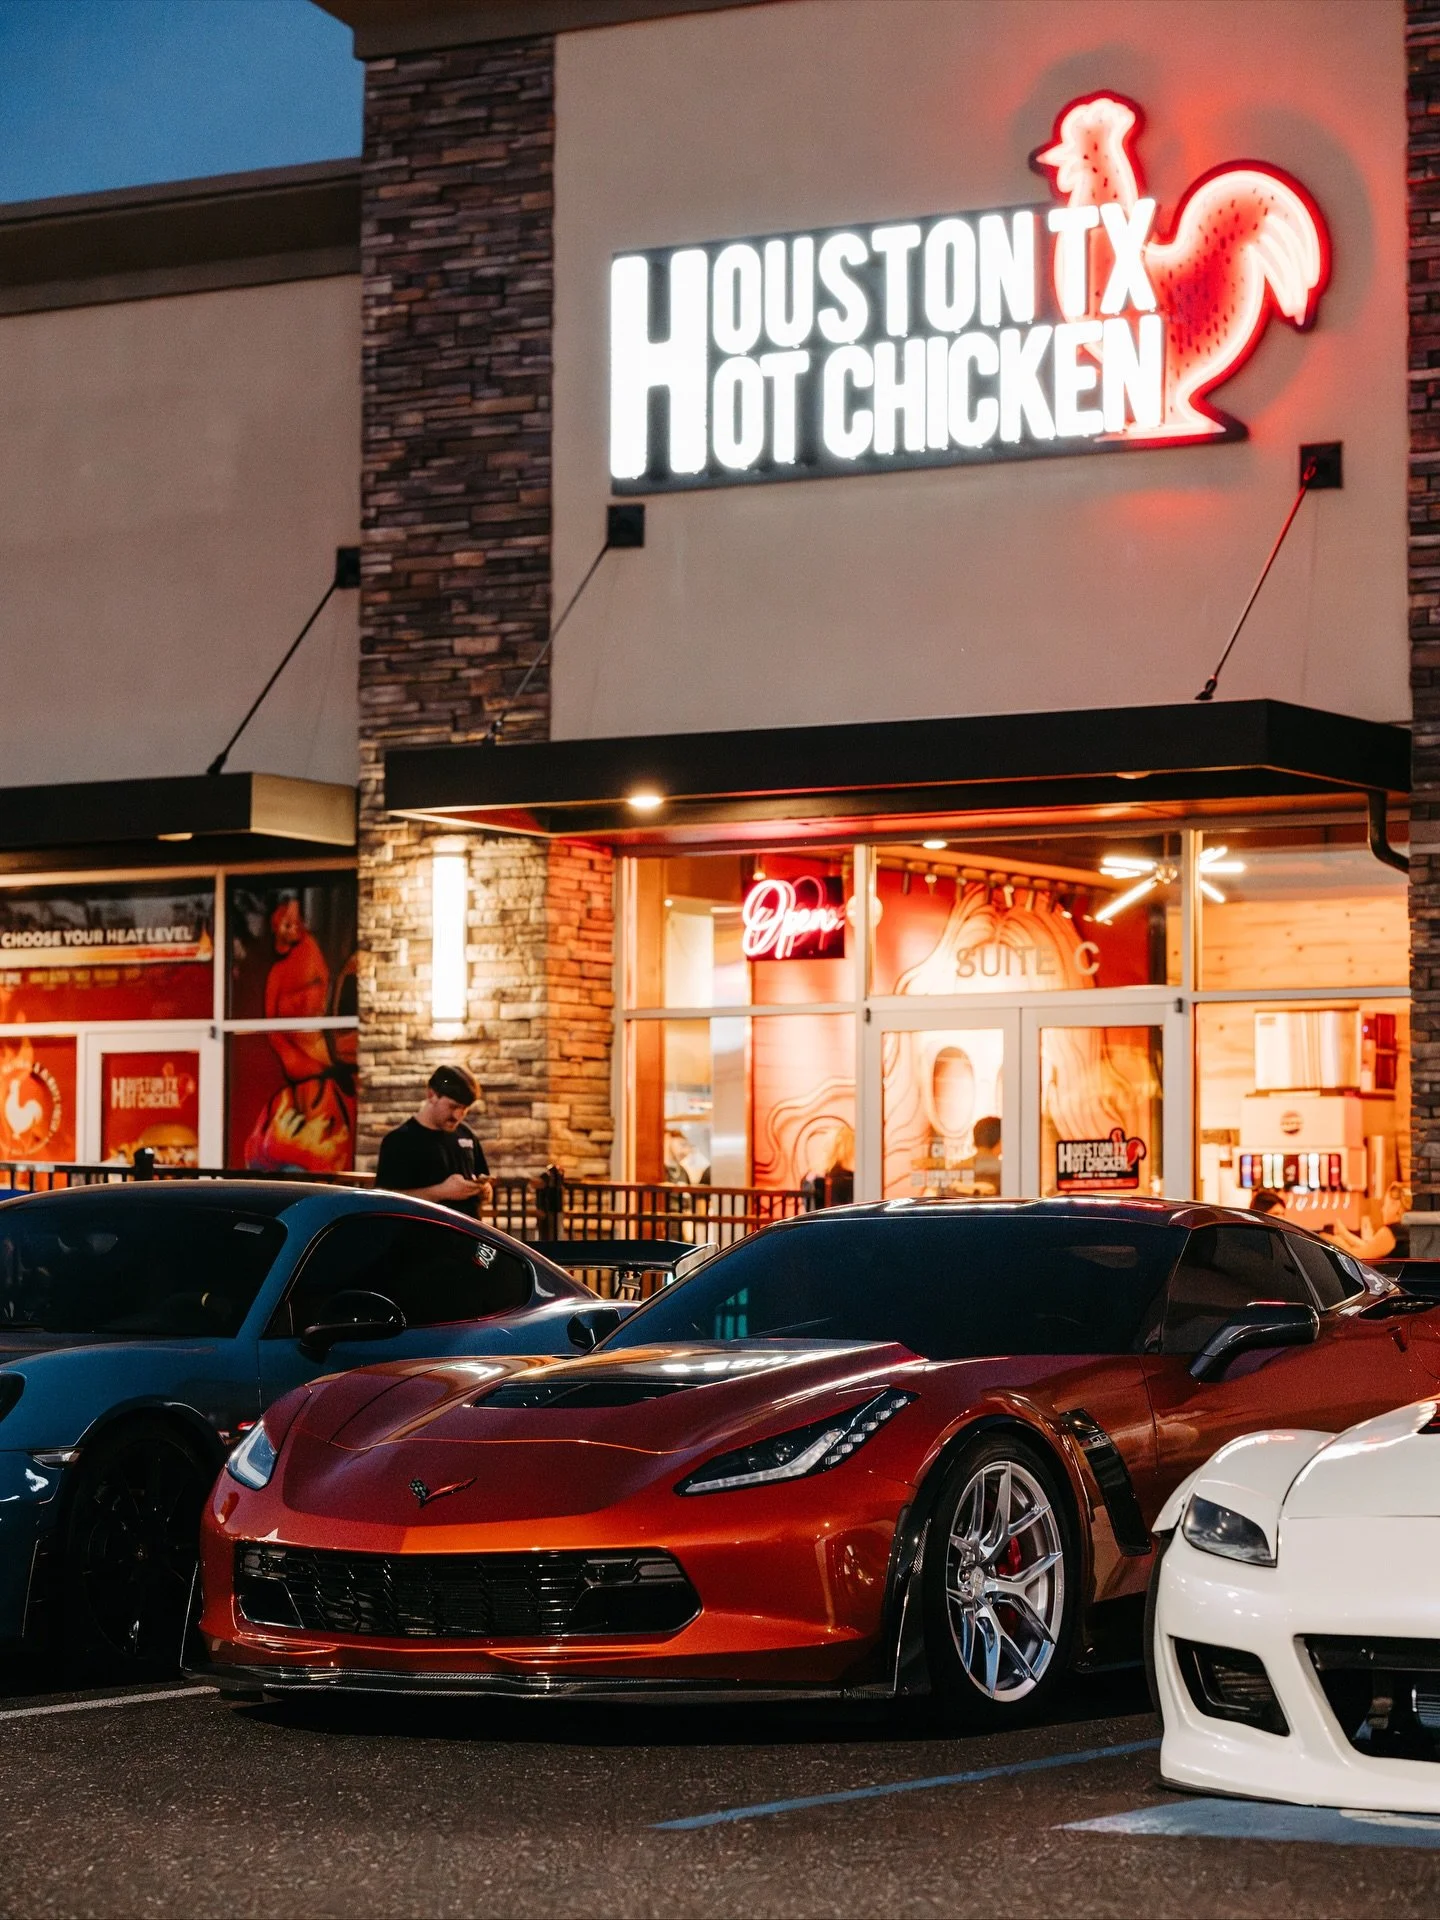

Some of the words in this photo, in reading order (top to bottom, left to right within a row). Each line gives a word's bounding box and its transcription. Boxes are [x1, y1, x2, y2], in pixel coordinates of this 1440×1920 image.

[610, 211, 1035, 478] HOUSTON
[1048, 198, 1157, 315] TX
[822, 315, 1163, 461] CHICKEN
[1, 931, 62, 948] CHOOSE
[63, 929, 104, 945] YOUR
[106, 927, 144, 944] HEAT
[147, 925, 193, 942] LEVEL
[956, 946, 1056, 977] SUITE
[1073, 941, 1100, 977] C
